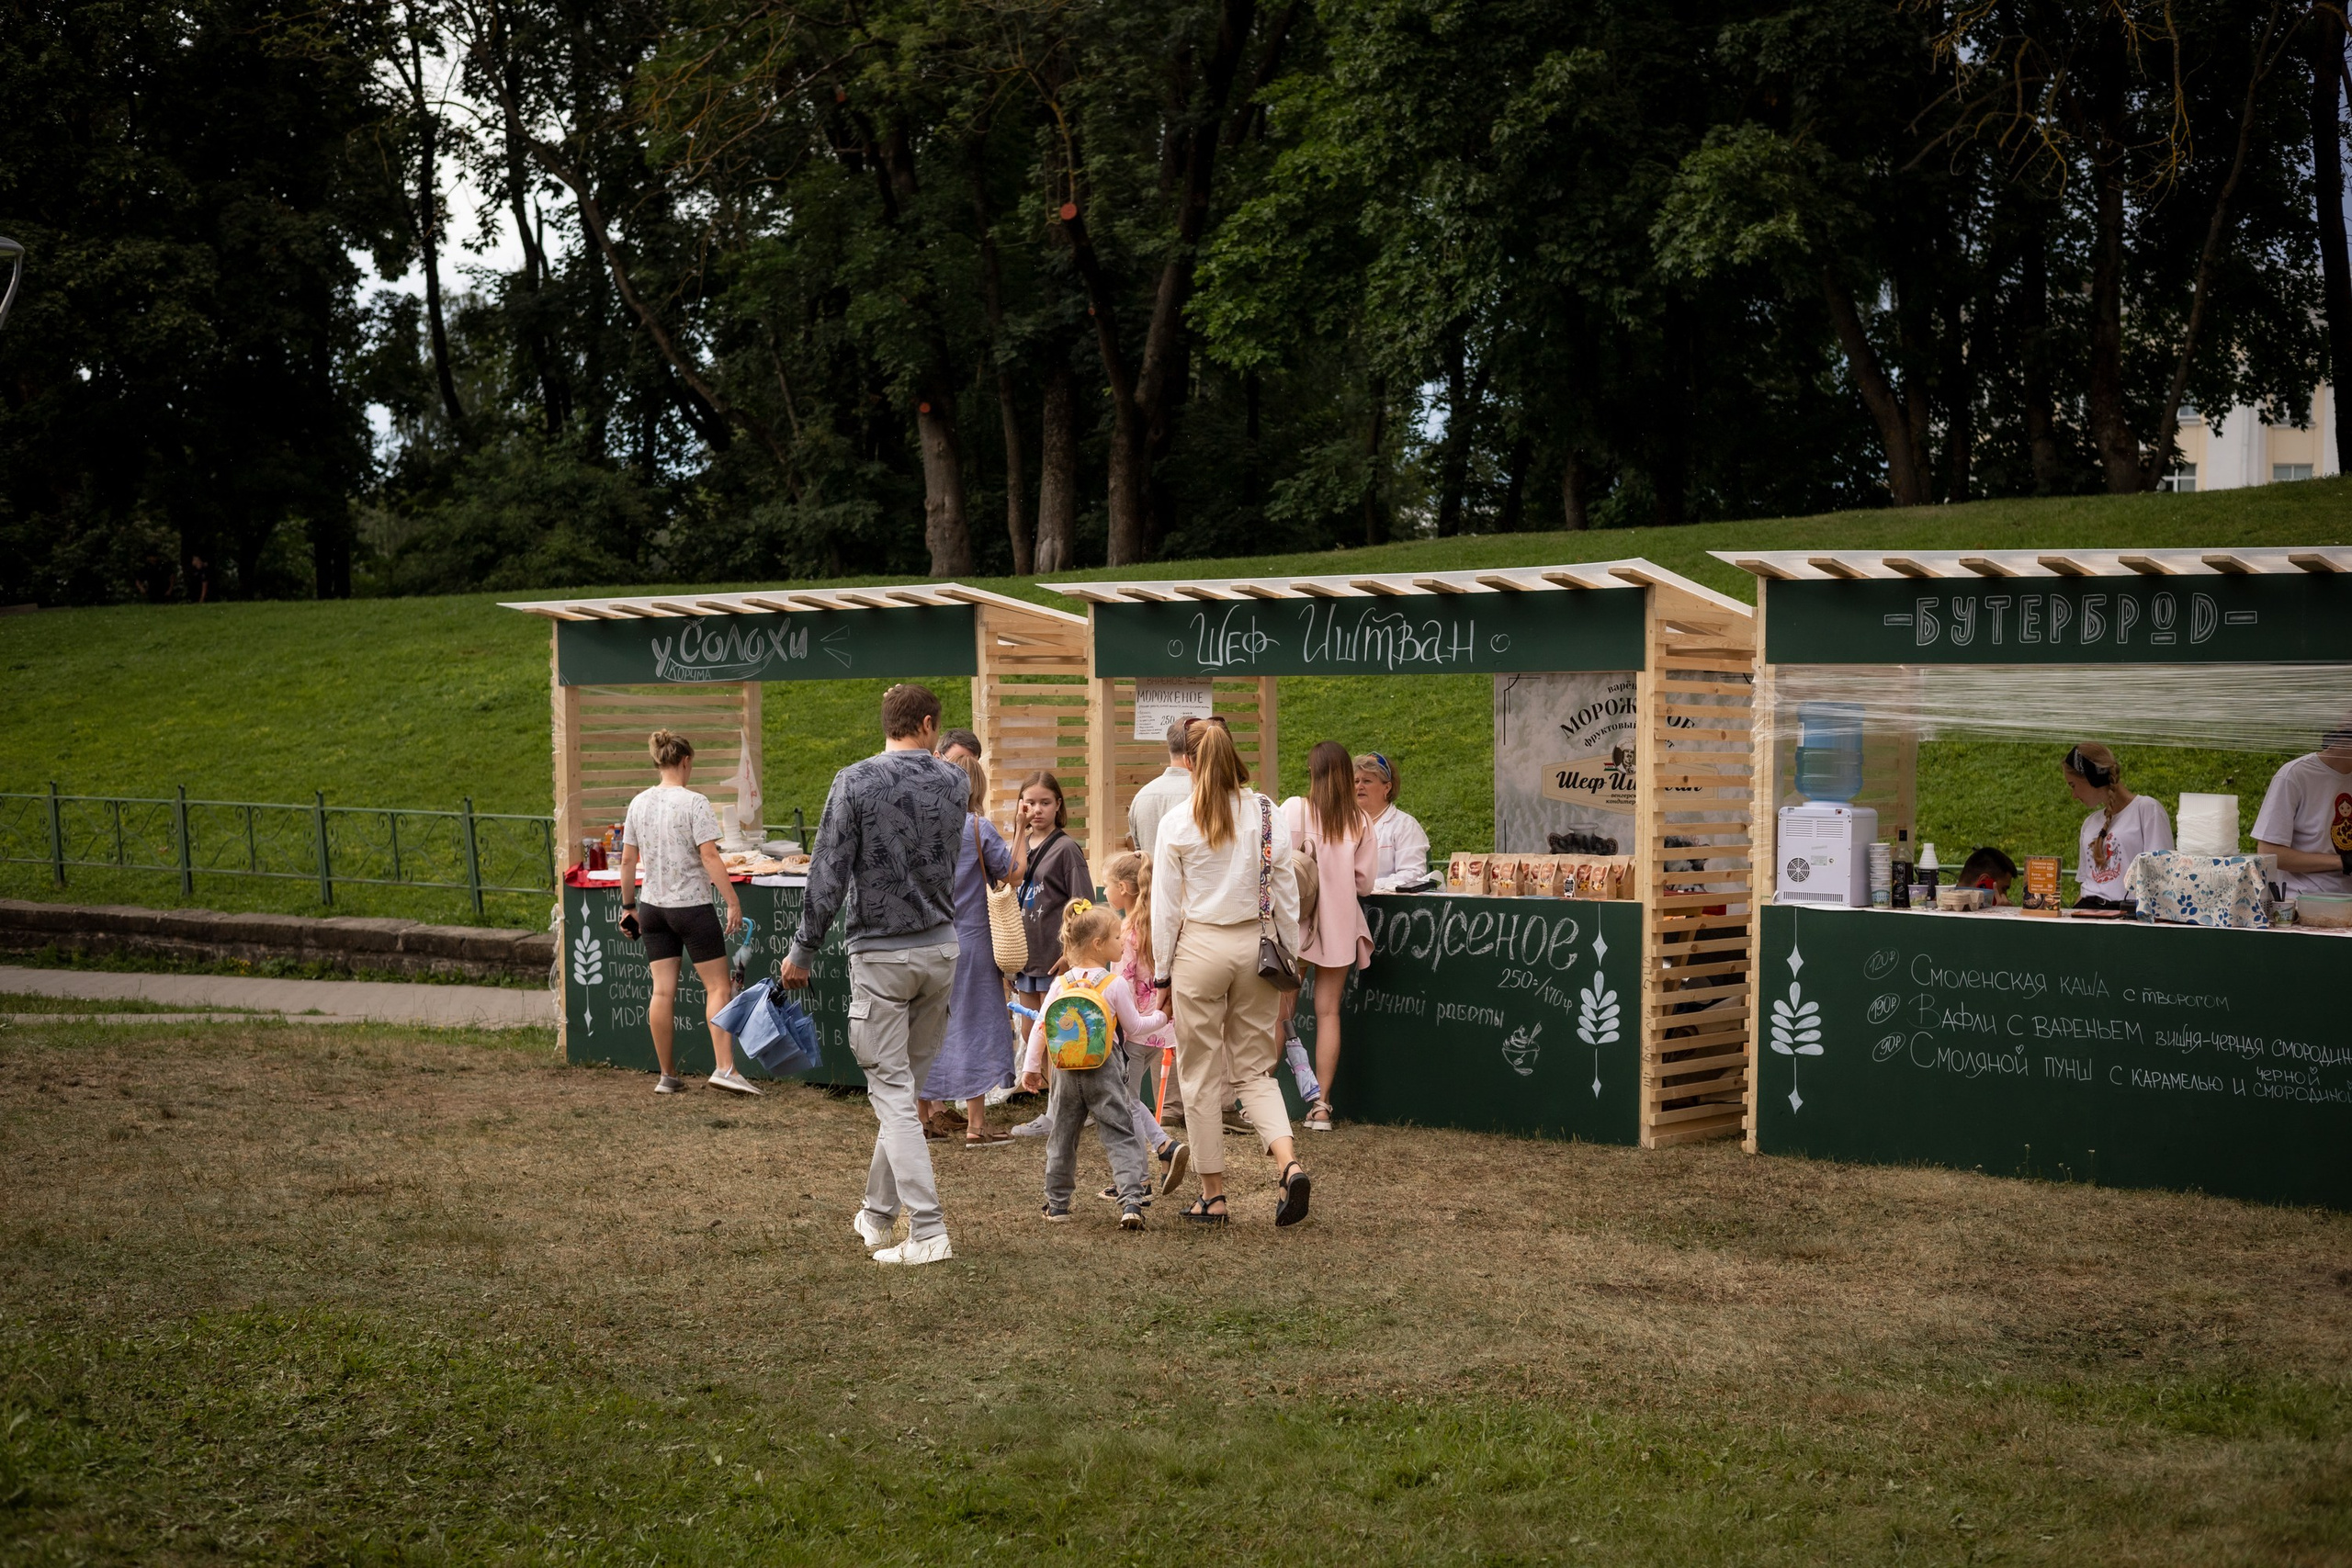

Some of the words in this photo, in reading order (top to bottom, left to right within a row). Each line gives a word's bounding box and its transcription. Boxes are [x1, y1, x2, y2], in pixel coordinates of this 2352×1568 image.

[1136, 689, 1204, 704] МОРОЖЕНОЕ
[1607, 680, 1637, 694] варён
[1583, 720, 1637, 749] фруктовы
[1555, 771, 1606, 795] Шеф
[609, 962, 654, 982] ПИРОЖ
[609, 980, 653, 1000] СОСИСК
[677, 987, 707, 1005] ТЕСТ
[2271, 1038, 2352, 1067] СМОРОДИН
